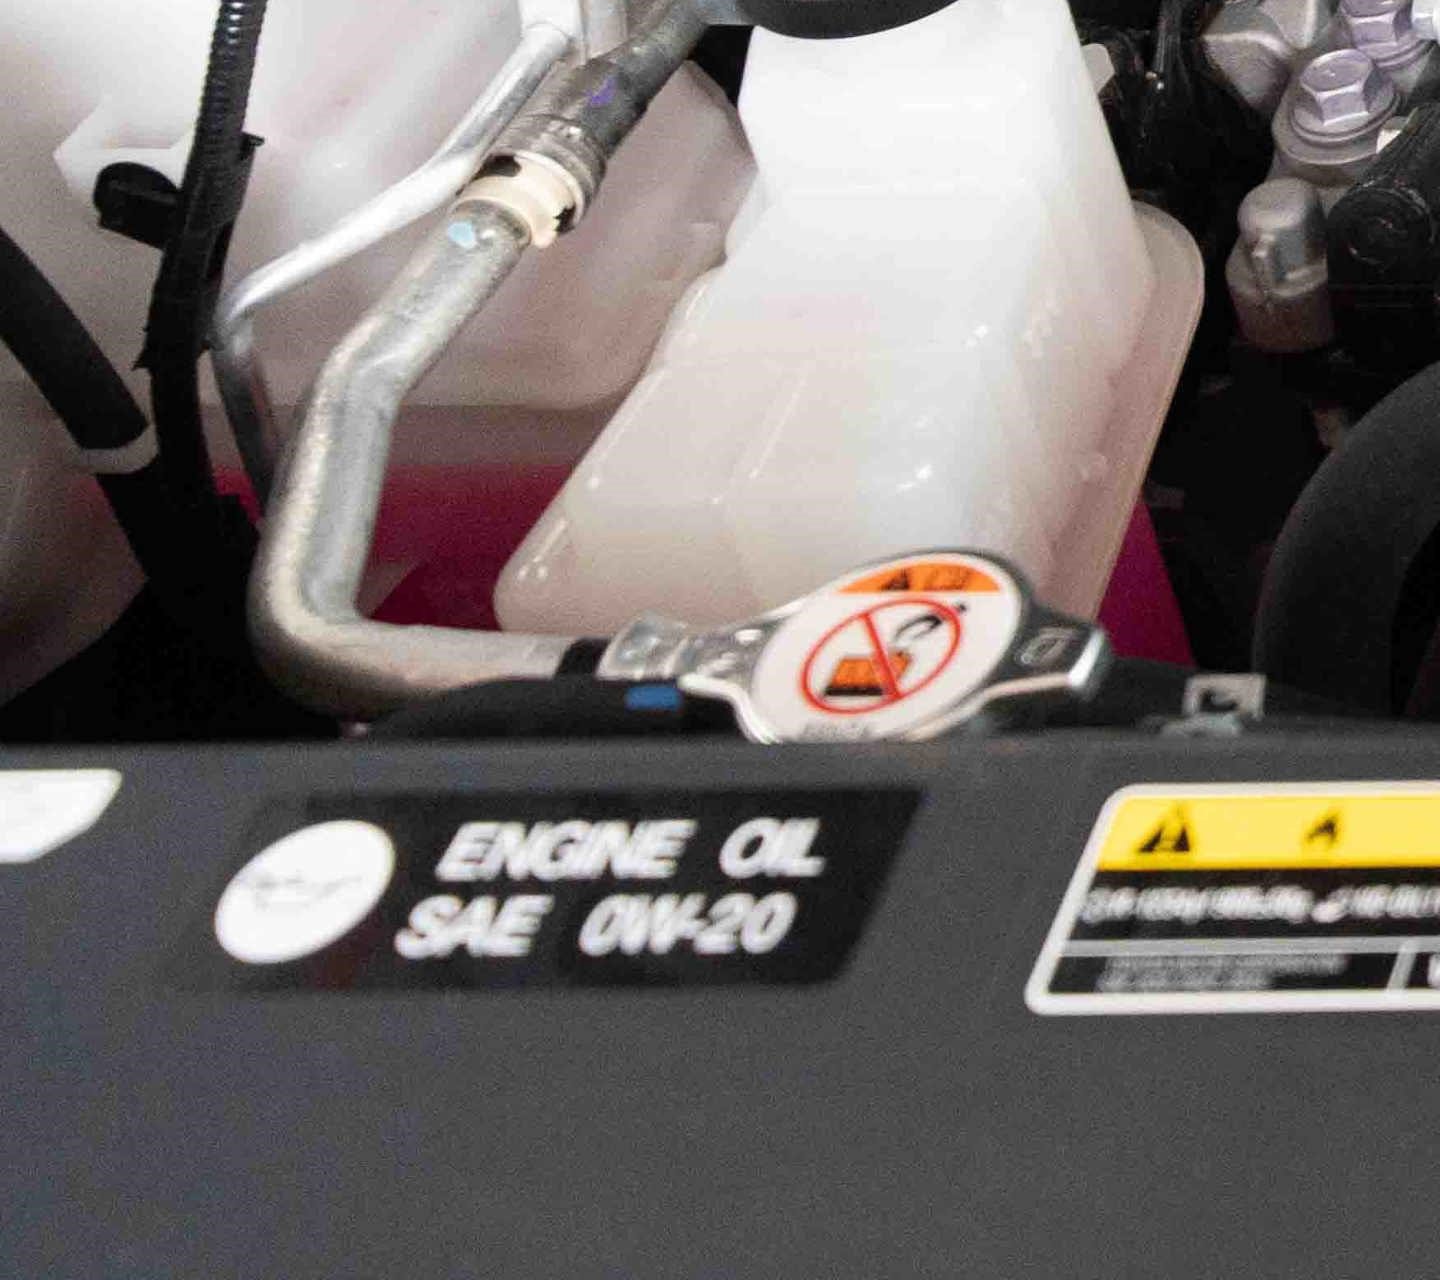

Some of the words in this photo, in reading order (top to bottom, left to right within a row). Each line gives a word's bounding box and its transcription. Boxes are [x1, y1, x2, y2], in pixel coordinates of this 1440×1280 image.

[437, 819, 697, 882] ENGINE
[720, 817, 824, 879] OIL
[393, 893, 555, 959] SAE
[577, 891, 799, 957] 0W-20
